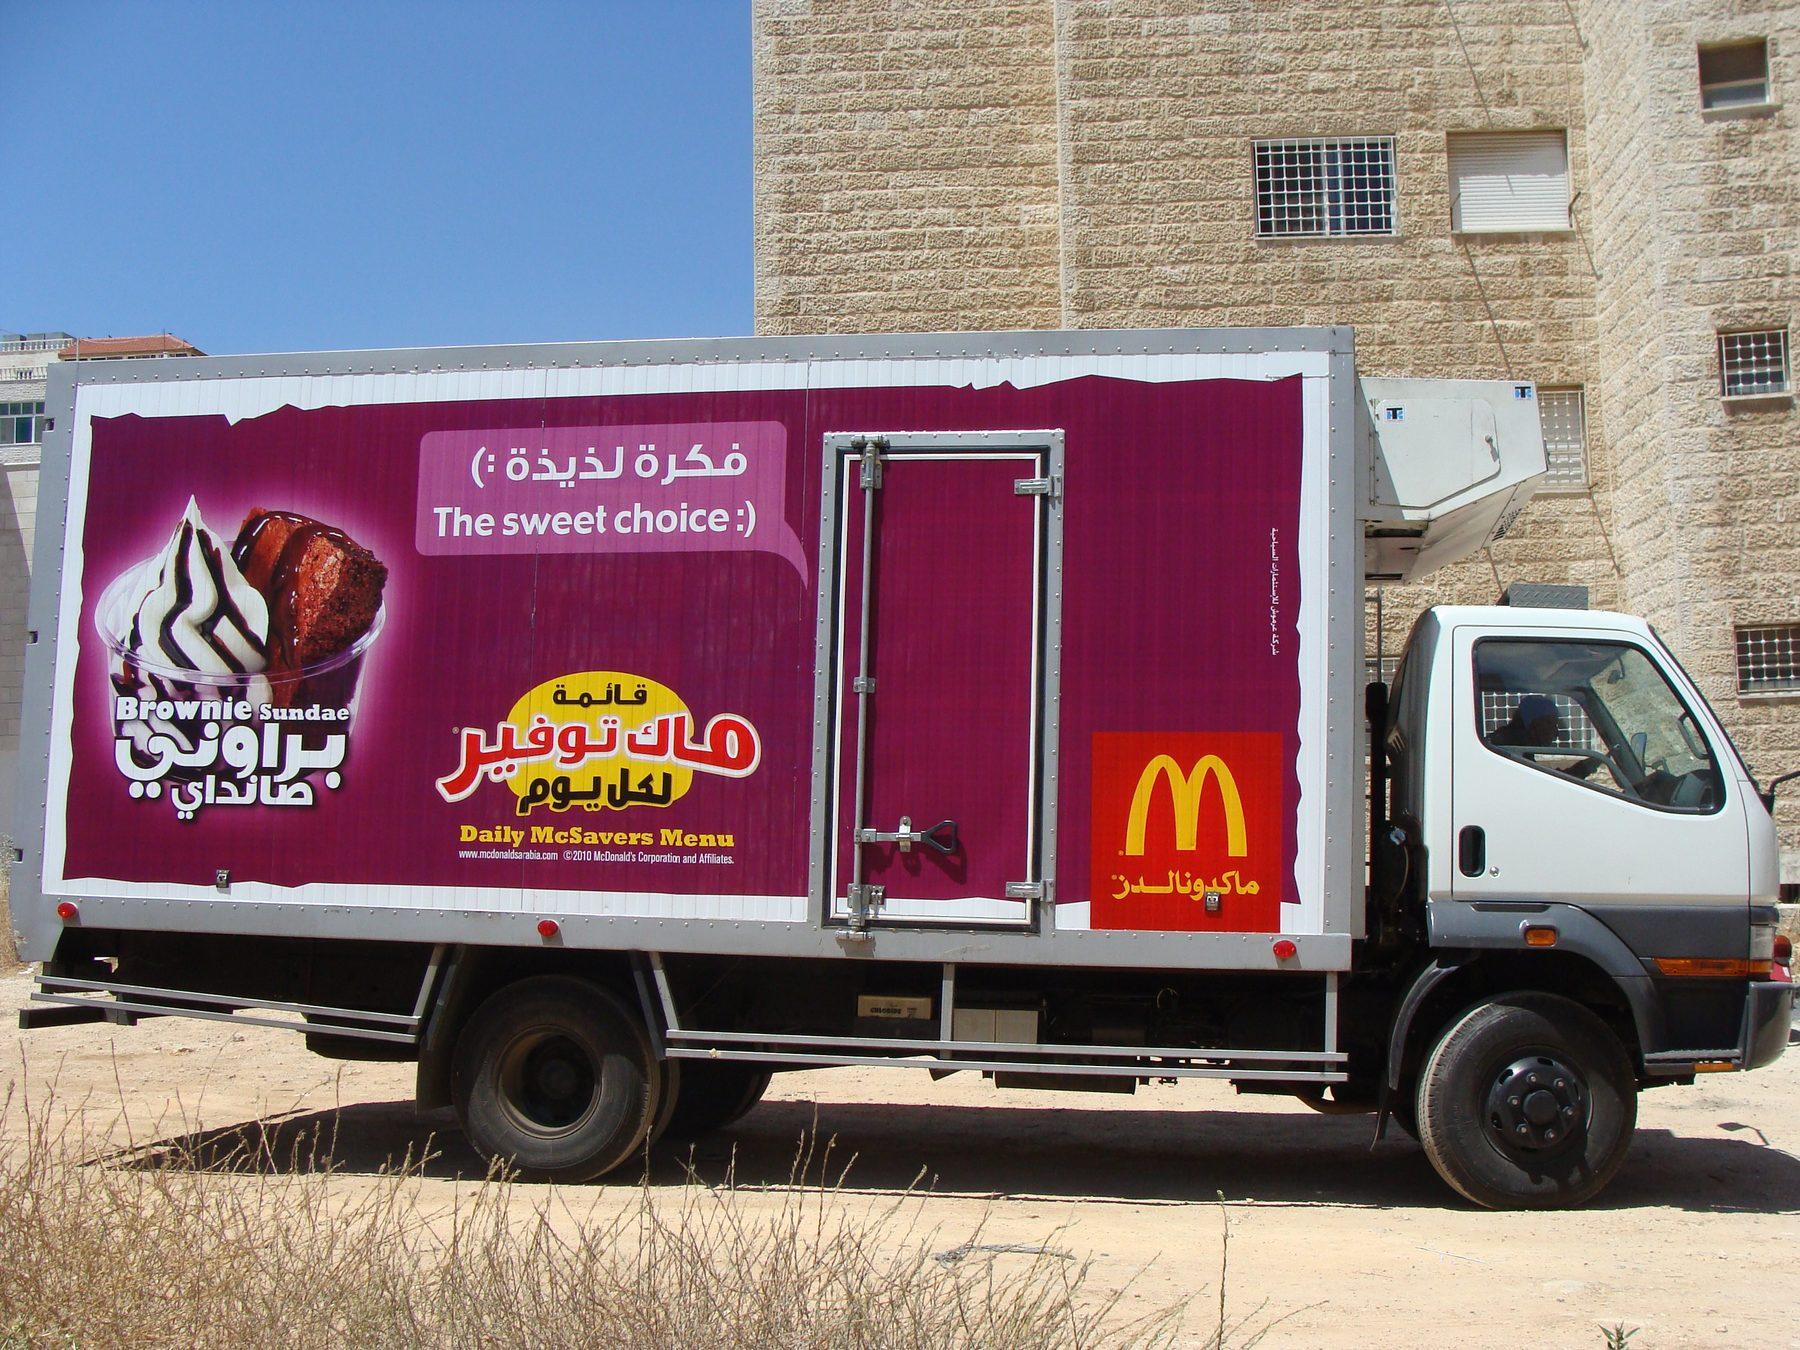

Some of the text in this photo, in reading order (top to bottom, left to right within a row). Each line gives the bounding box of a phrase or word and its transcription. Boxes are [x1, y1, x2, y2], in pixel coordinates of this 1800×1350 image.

[505, 446, 624, 488] لذيذة
[633, 442, 748, 486] فكرة
[433, 506, 495, 538] The
[502, 504, 607, 536] sweet
[613, 502, 730, 534] choice
[1270, 633, 1279, 656] شركة
[116, 696, 350, 721] Brownie Sundae
[552, 683, 648, 709] قائمة
[114, 721, 346, 799] براوني
[435, 713, 761, 803] ماك توفير
[171, 774, 314, 820] صانداي
[518, 768, 673, 814] لكل يوم
[1125, 754, 1248, 857] M
[460, 825, 735, 847] Daily McSavers Menu
[459, 849, 558, 861] www.mcdonaldsarabia.com
[593, 851, 636, 862] McDonald's
[638, 851, 681, 864] Corporation
[682, 853, 697, 864] and
[699, 853, 735, 864] Affiliates.
[1112, 869, 1260, 902] ماكدونالدز
